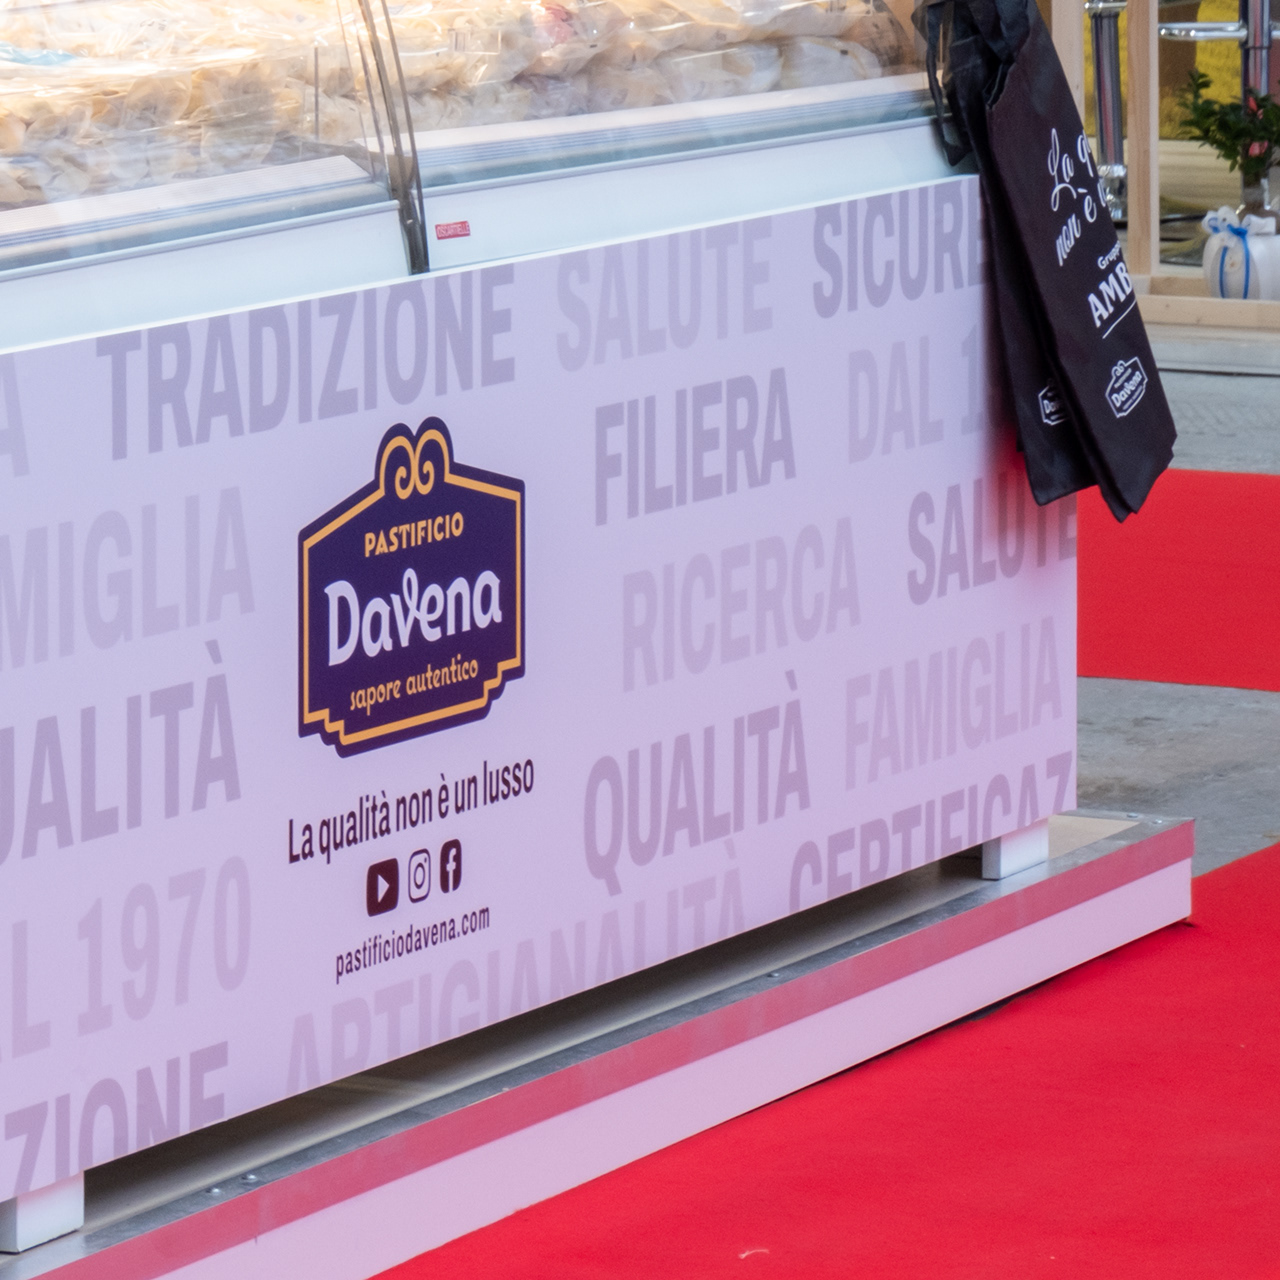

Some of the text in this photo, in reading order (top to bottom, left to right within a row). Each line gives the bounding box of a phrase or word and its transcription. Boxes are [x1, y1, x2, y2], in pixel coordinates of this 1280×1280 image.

[555, 214, 774, 373] SALUTE
[96, 263, 517, 462] TRADIZIONE
[594, 366, 797, 527] FILIERA
[848, 334, 944, 465] DAL
[364, 511, 464, 558] PASTIFICIO
[323, 567, 503, 666] Davena
[621, 516, 862, 693] RICERCA
[350, 653, 479, 716] sapore autentico
[76, 854, 252, 1039] 1970
[583, 669, 812, 897] QUALITÀ
[844, 615, 1063, 791] FAMIGLIA
[288, 758, 534, 865] La qualità non è un lusso
[335, 907, 490, 985] pastificiodavena.com
